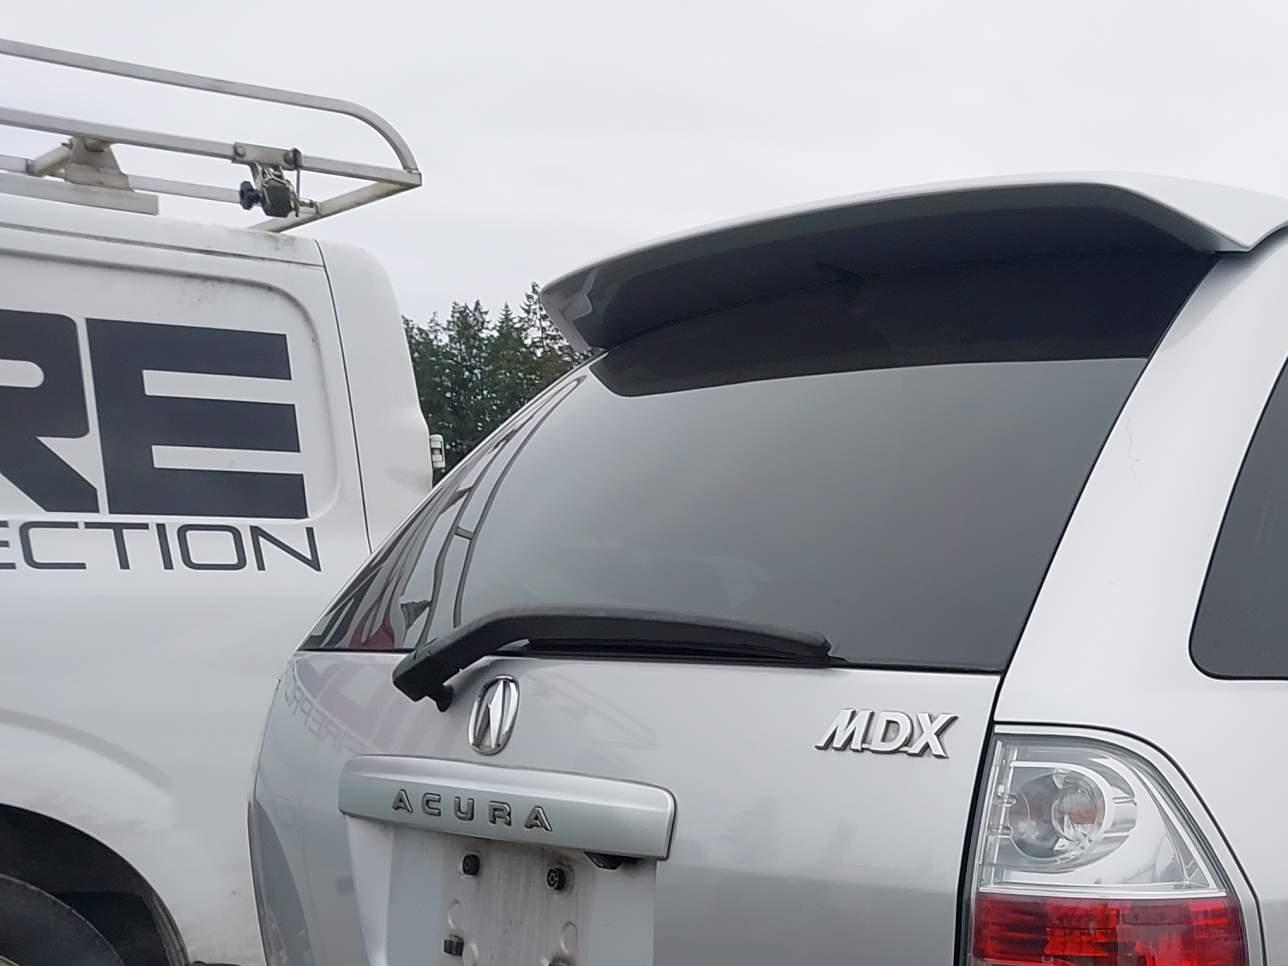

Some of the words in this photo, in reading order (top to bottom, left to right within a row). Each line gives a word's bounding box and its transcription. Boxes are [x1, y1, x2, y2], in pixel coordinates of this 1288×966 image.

[0, 520, 322, 573] CTION
[815, 707, 959, 760] MDX
[392, 788, 552, 832] ACURA
